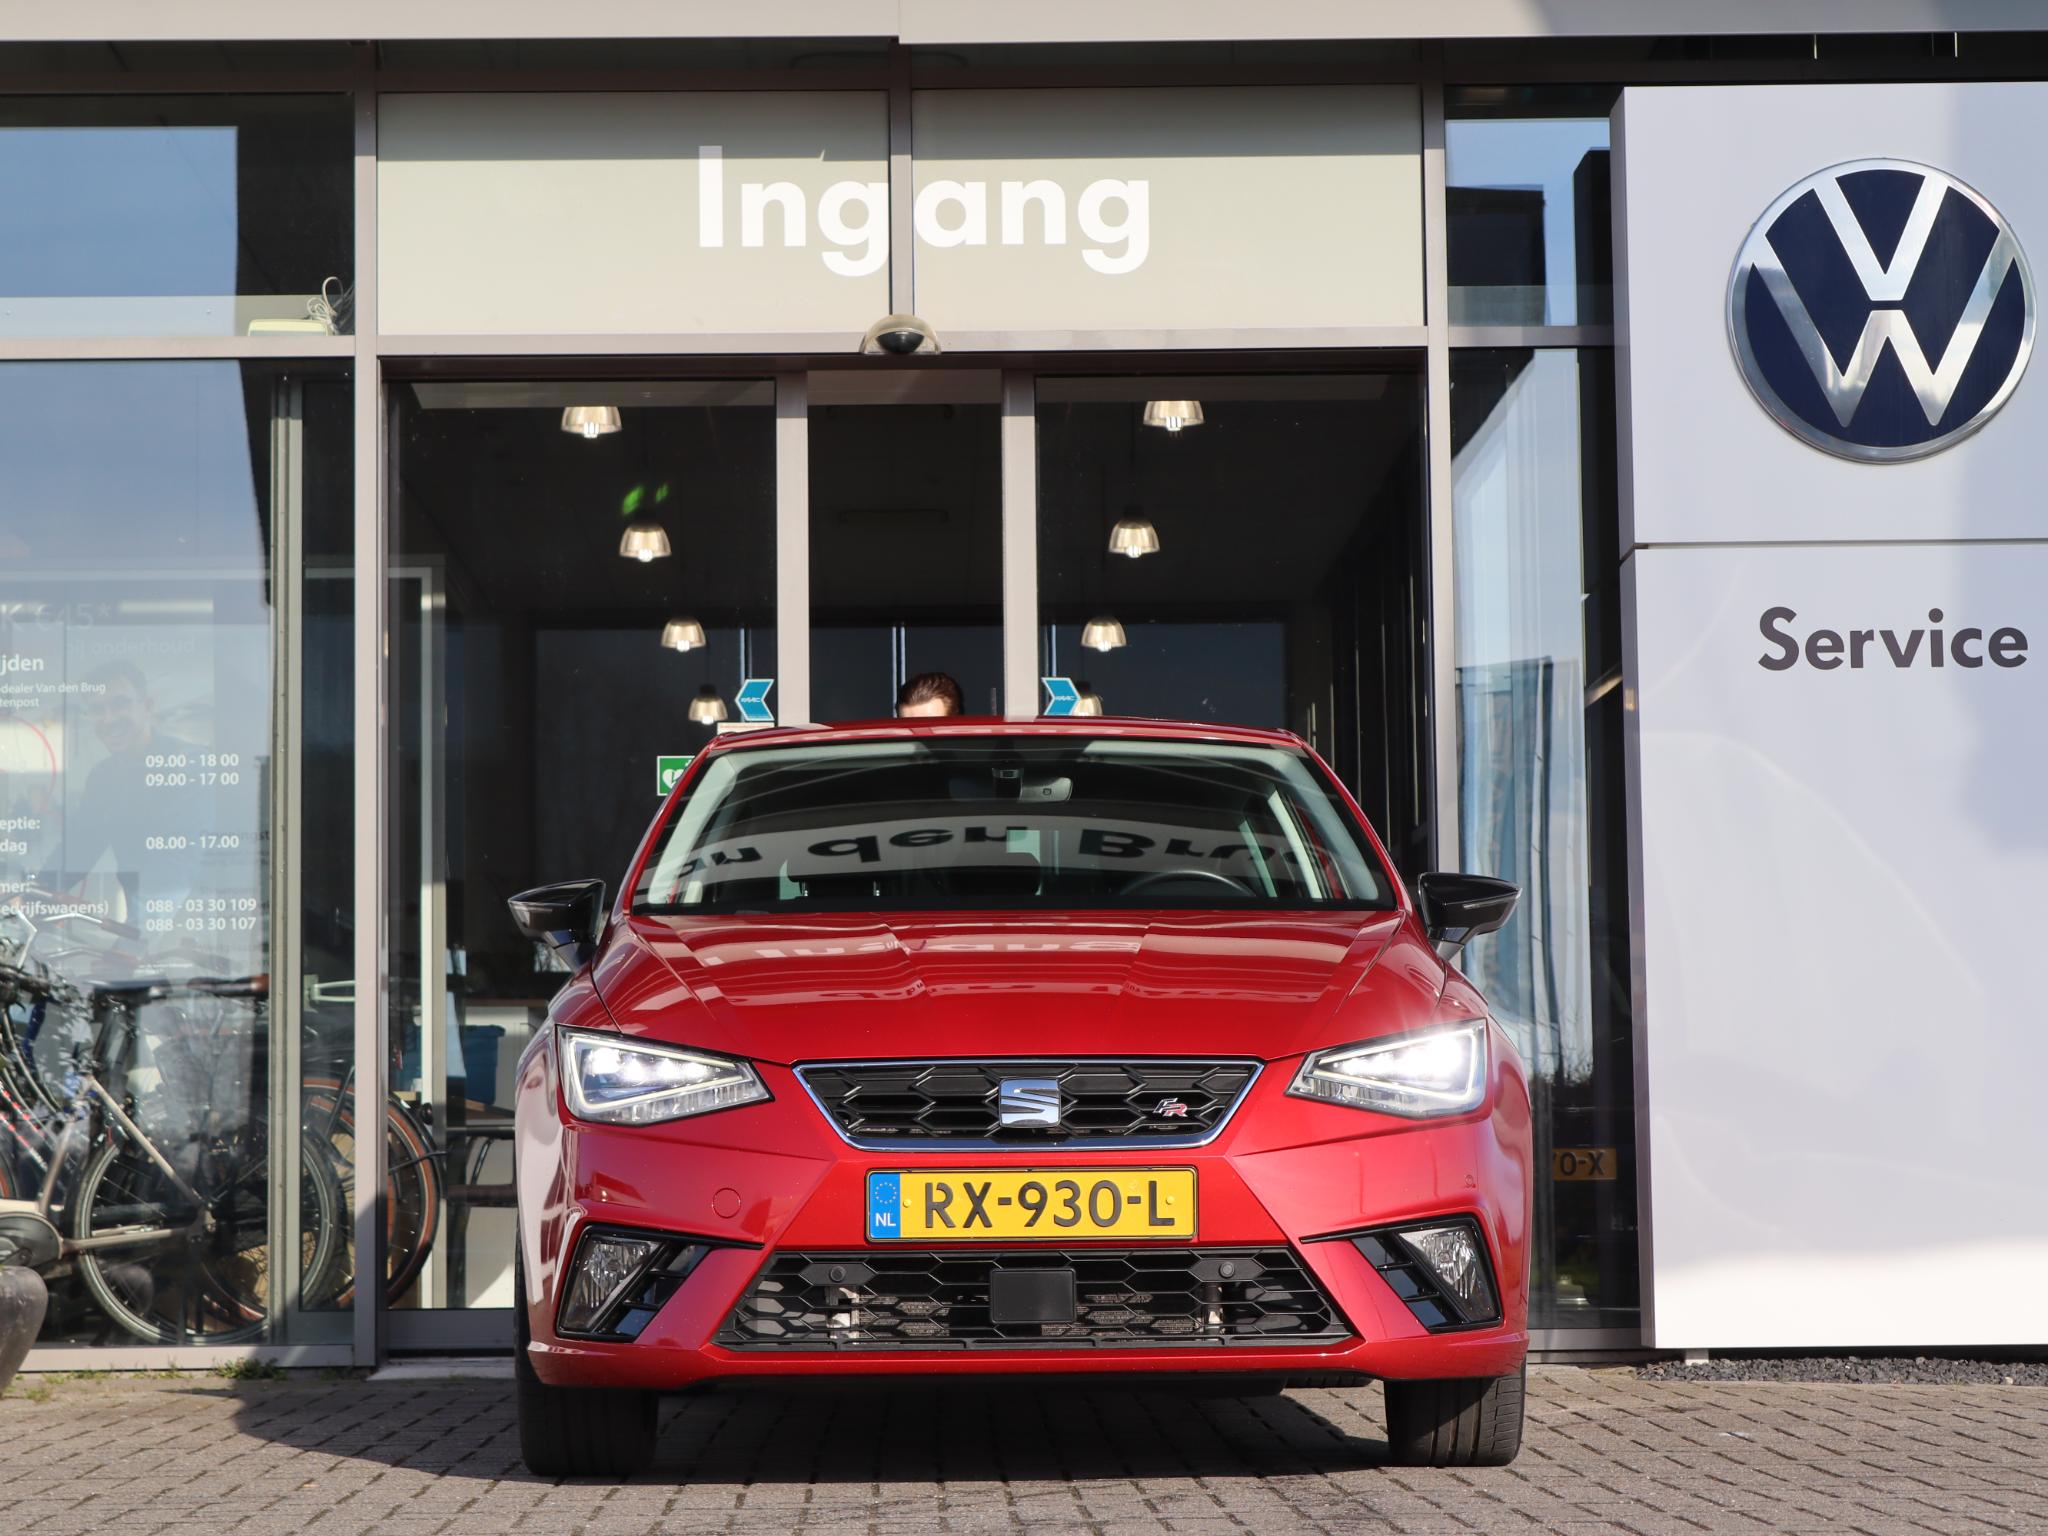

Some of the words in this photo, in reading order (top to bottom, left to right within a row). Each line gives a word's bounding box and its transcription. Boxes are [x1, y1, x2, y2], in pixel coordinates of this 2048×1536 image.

[699, 145, 1149, 277] Ingang
[1758, 606, 2029, 671] Service
[0, 683, 34, 694] dealer
[35, 683, 56, 694] Van
[58, 682, 78, 694] den
[81, 682, 106, 695] Brug
[145, 755, 186, 768] 09.00
[145, 773, 186, 786] 09.00
[146, 836, 187, 849] 08.00
[199, 835, 240, 848] 17.00
[146, 899, 174, 912] 088
[186, 899, 204, 912] 03
[208, 899, 226, 911] 30
[230, 898, 257, 911] 109
[146, 918, 174, 932] 088
[186, 918, 204, 931] 03
[208, 917, 226, 930] 30
[230, 917, 257, 930] 107
[1552, 1151, 1604, 1176] 0-X
[925, 1180, 1175, 1229] RX-930-L
[875, 1212, 896, 1227] NL
